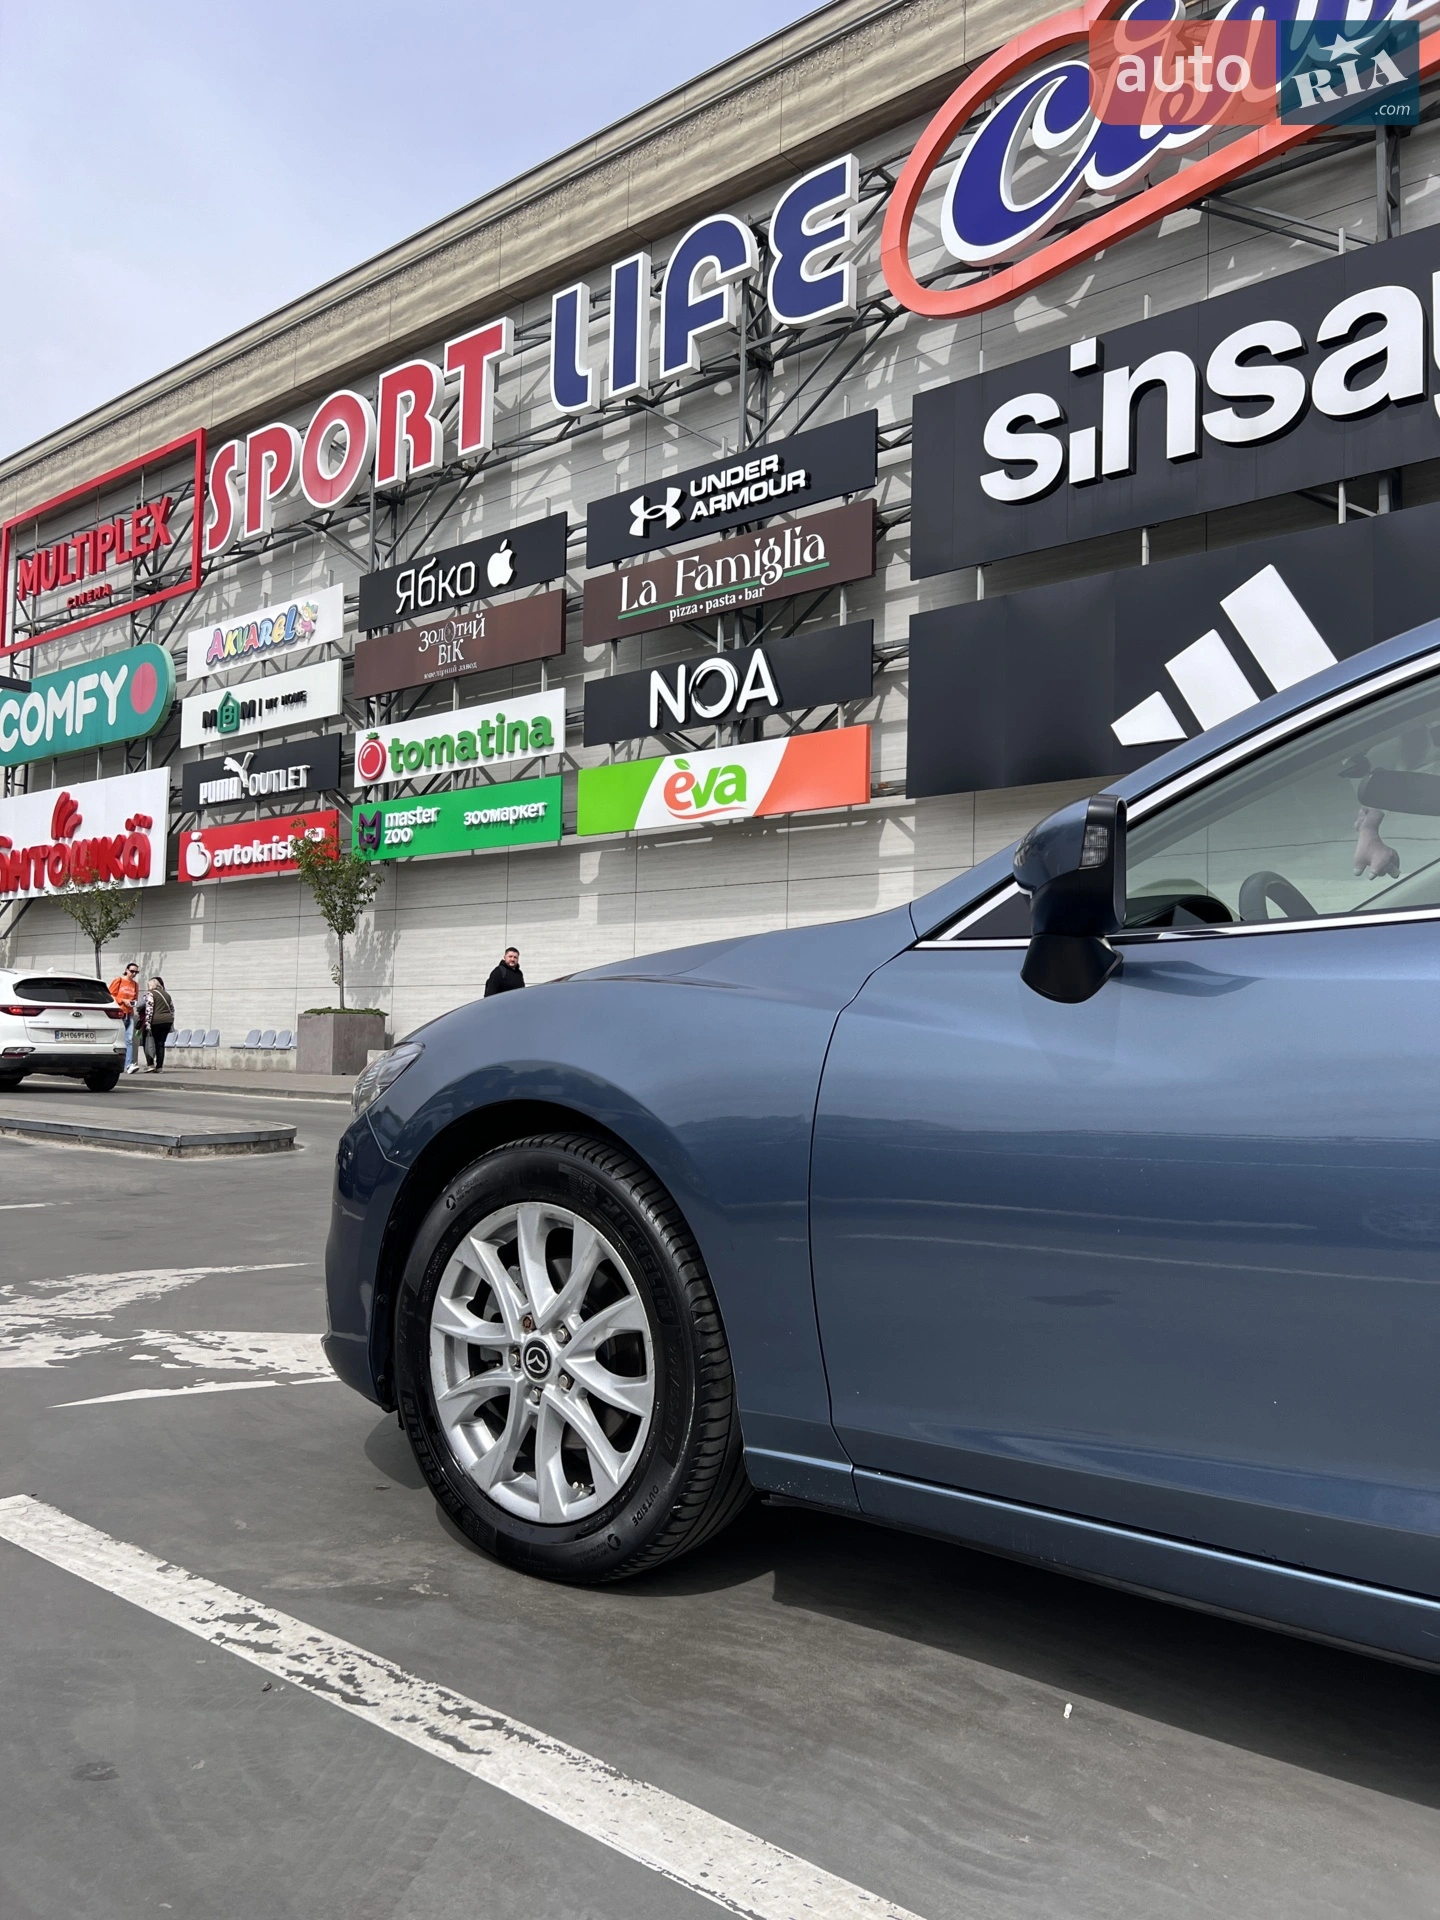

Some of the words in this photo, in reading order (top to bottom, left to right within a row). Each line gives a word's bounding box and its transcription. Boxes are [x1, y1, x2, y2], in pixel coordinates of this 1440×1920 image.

[206, 316, 514, 557] SPORT
[548, 153, 859, 416] LIFE
[980, 271, 1440, 501] sinsa
[689, 453, 780, 497] UNDER
[689, 469, 806, 521] ARMOUR
[18, 496, 173, 601] MULTIPLEX
[619, 575, 659, 613] La
[674, 525, 827, 597] Famiglia
[67, 583, 114, 610] CINEMA
[396, 557, 477, 615] Ябко
[669, 604, 699, 622] pizza
[705, 594, 737, 618] pasta
[744, 587, 766, 602] bar
[206, 604, 299, 667] AKVAREL
[0, 664, 129, 753] COMFY
[649, 648, 779, 729] NOA
[388, 713, 555, 774] tomatina
[249, 764, 311, 797] OUTLET
[384, 805, 441, 829] master
[384, 827, 414, 845] zoo
[463, 801, 548, 826] зоомаркет
[631, 1484, 660, 1527] OUTSIDE
